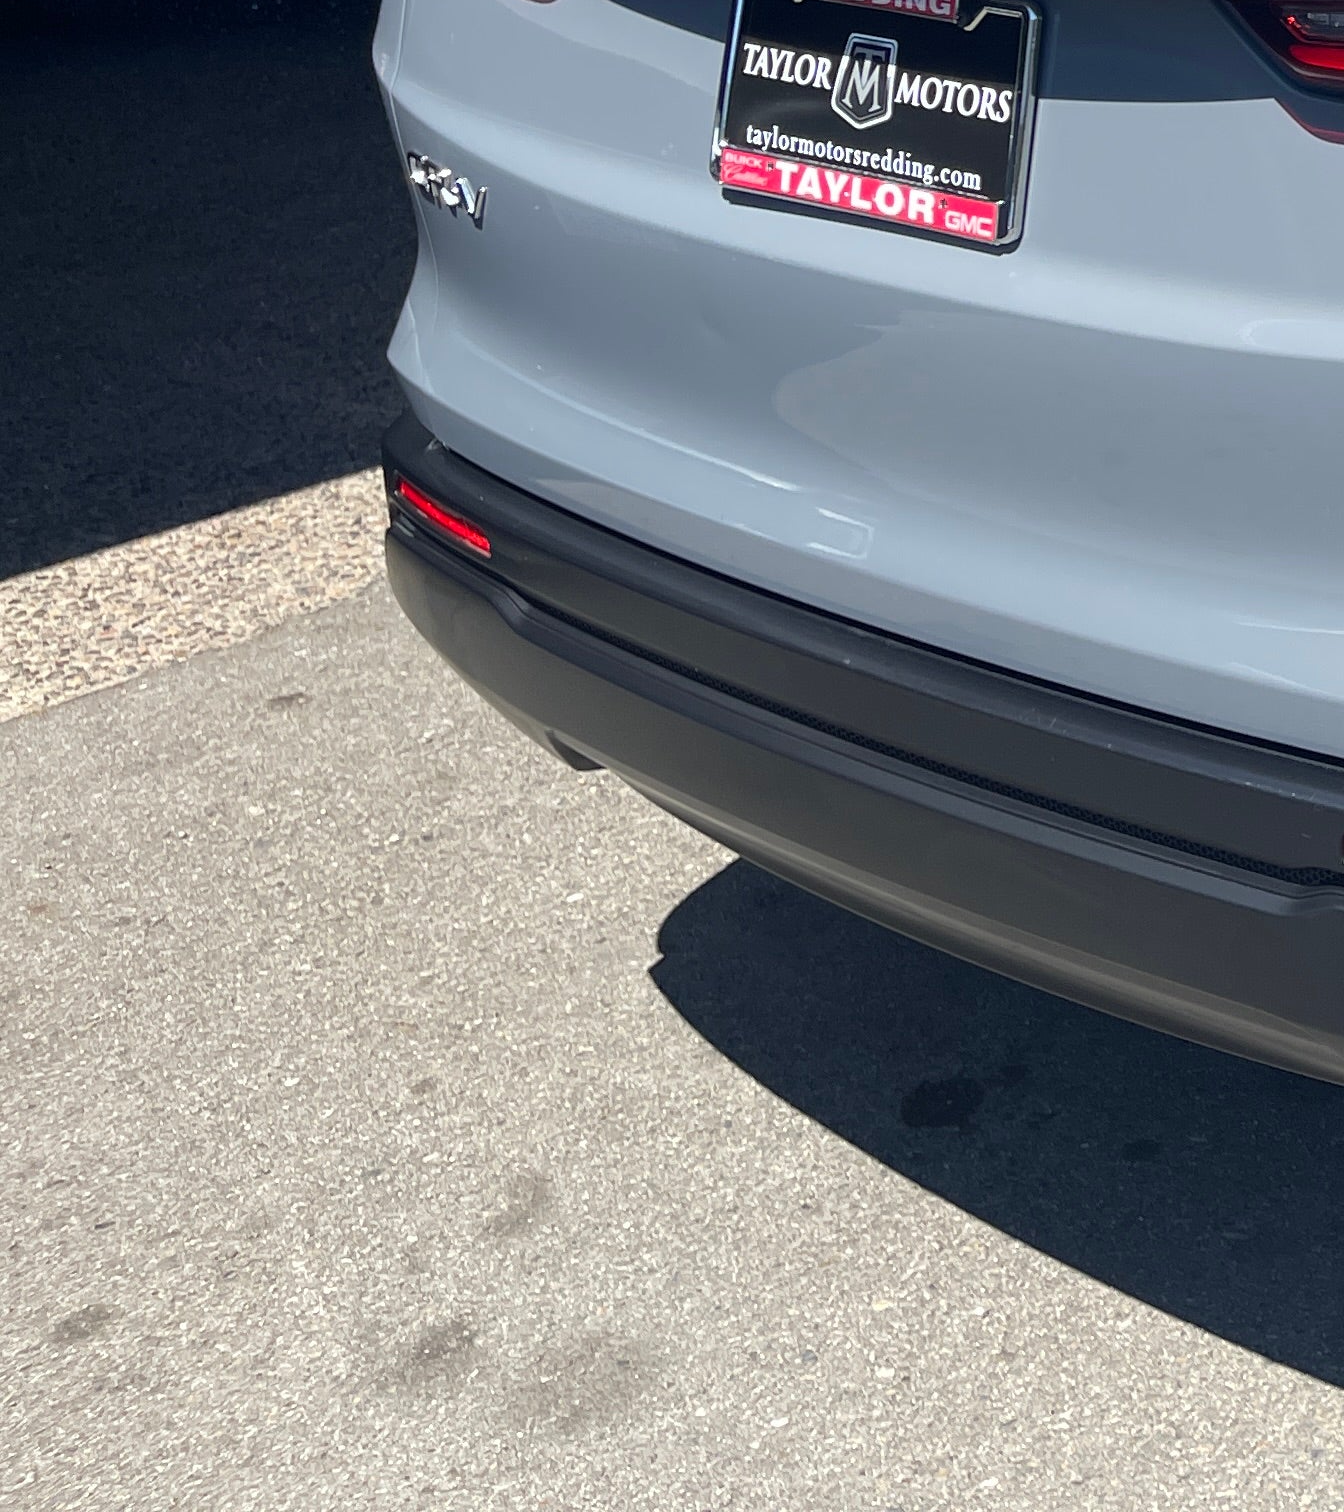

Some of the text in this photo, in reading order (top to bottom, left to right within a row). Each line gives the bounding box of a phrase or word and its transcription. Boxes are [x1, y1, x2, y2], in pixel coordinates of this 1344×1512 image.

[743, 42, 1013, 124] TAYLOR MOTORS
[724, 151, 763, 169] BUICK
[746, 124, 982, 191] taylormotorsredding.com
[775, 159, 935, 224] TAYLOR
[944, 210, 994, 237] GMC
